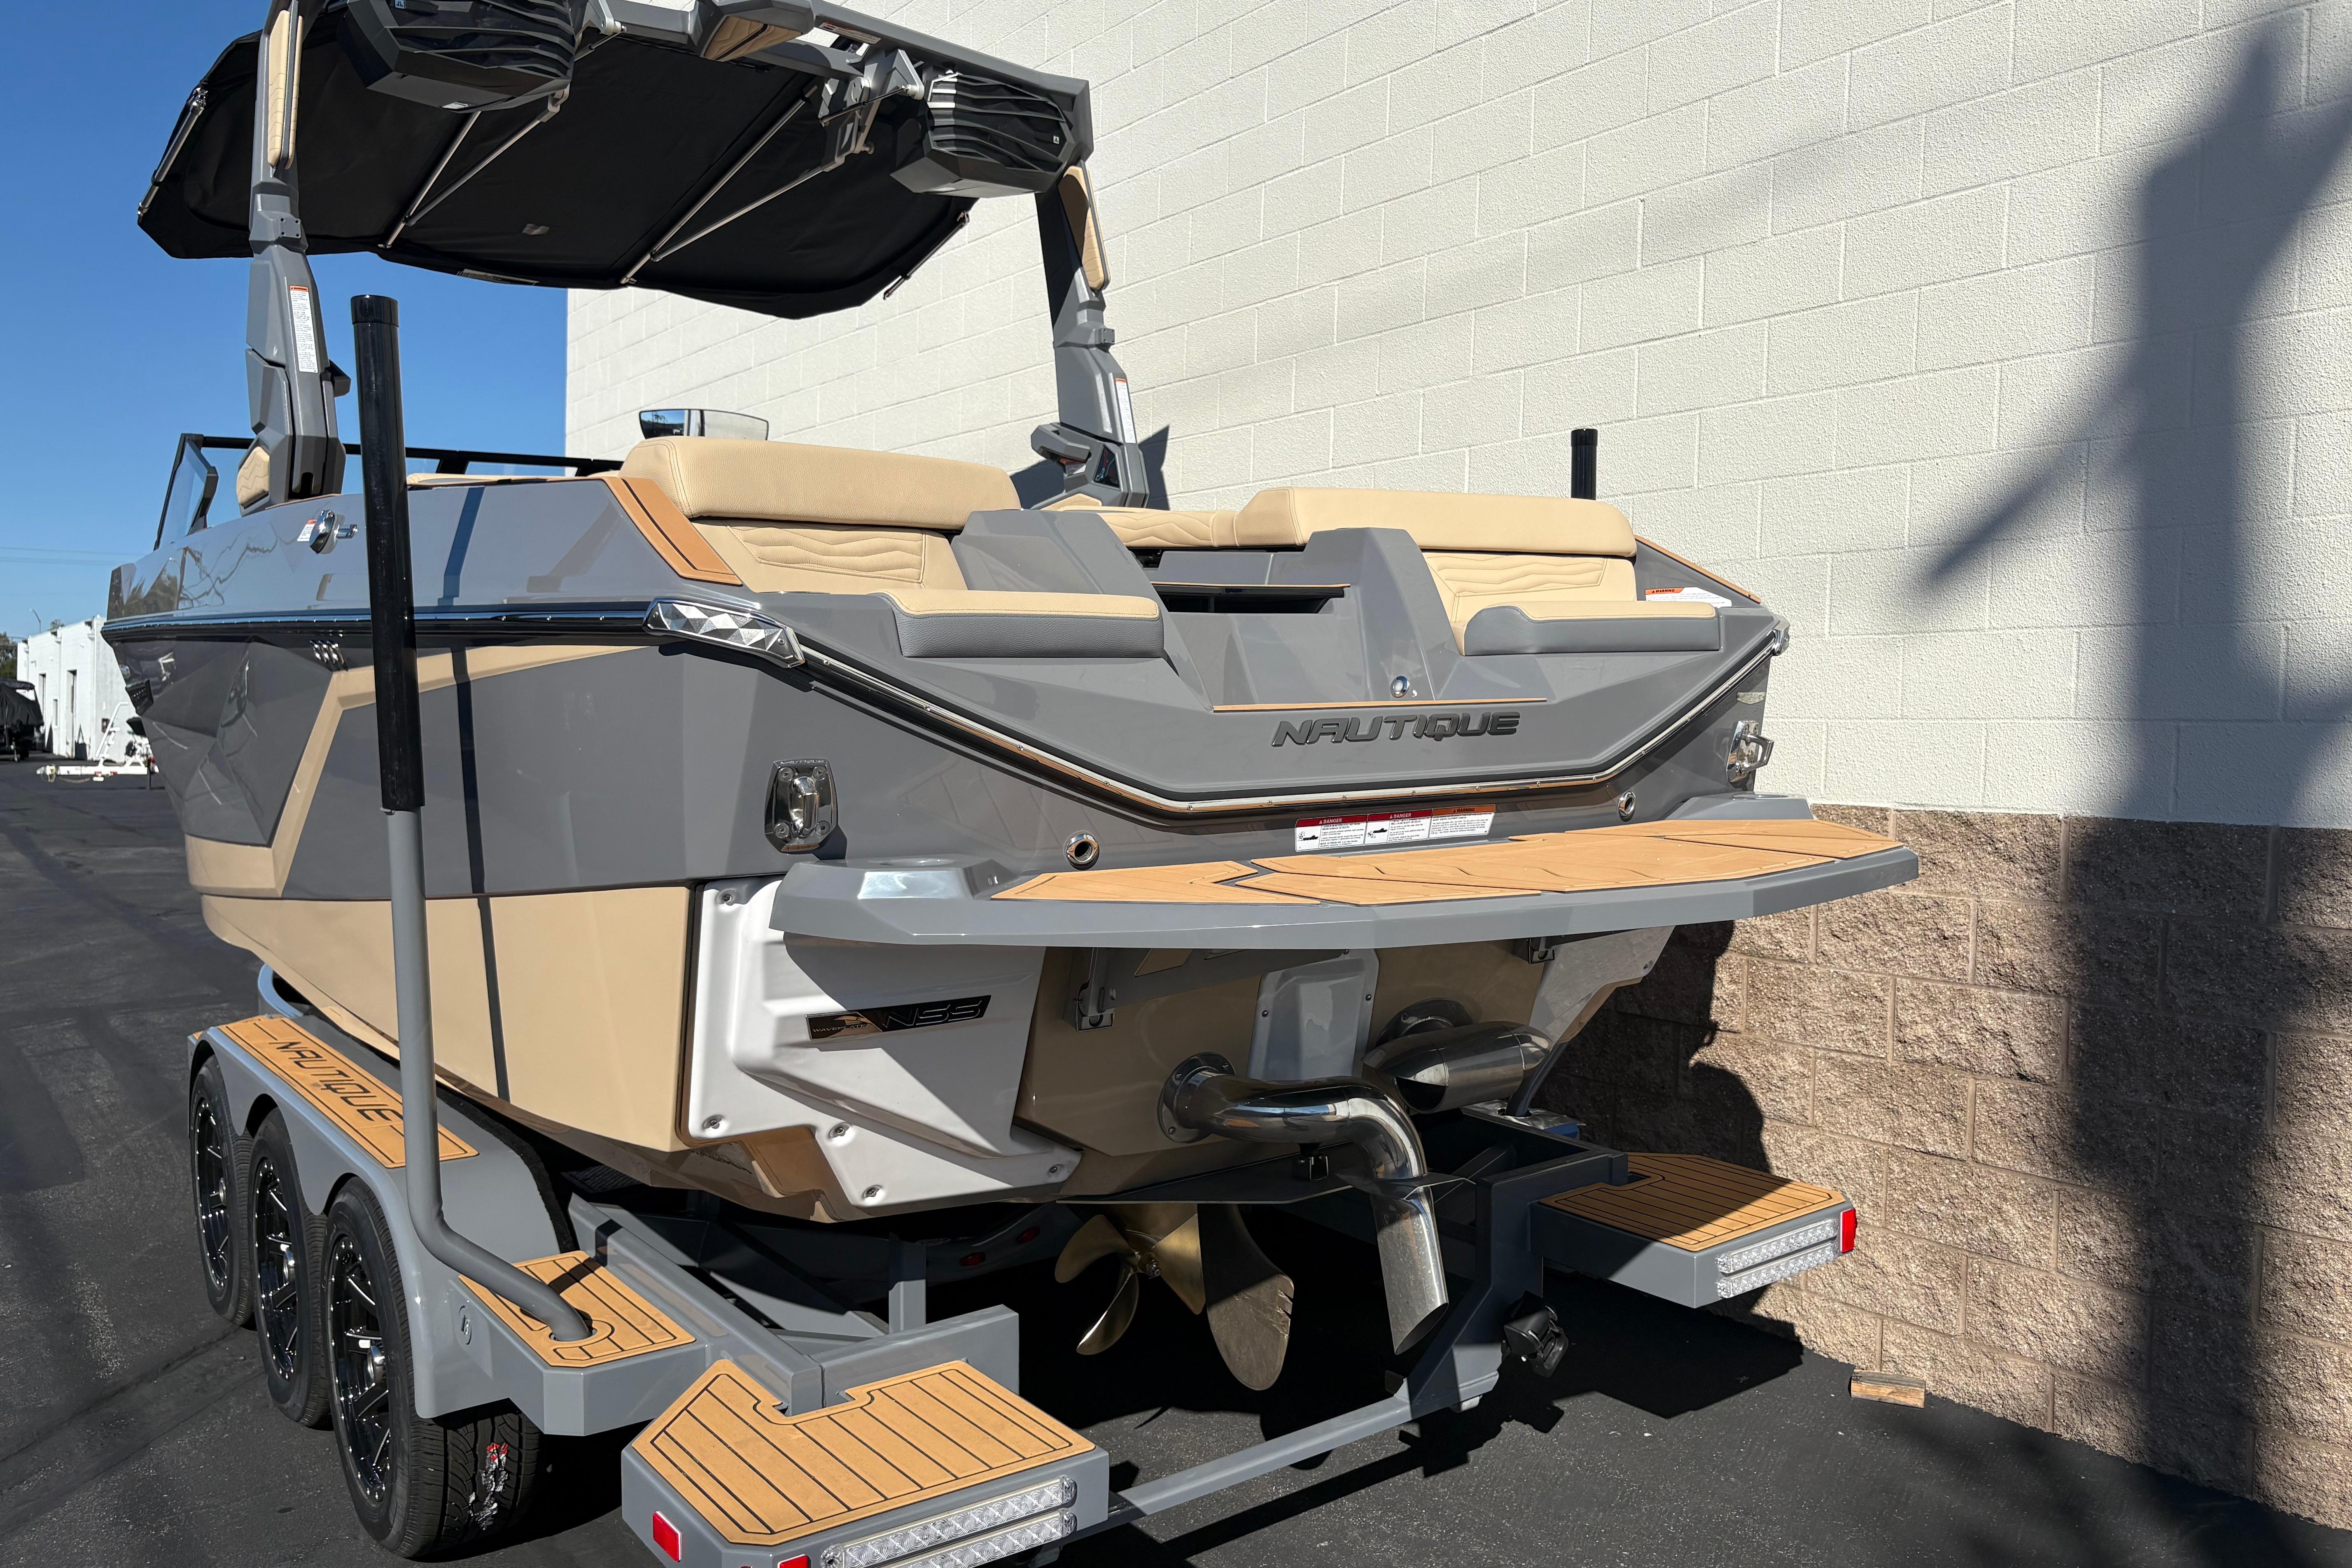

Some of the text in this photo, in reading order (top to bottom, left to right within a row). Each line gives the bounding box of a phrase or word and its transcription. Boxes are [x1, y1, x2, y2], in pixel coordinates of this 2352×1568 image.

[1272, 712, 1521, 747] NAUTIQUE
[882, 1000, 982, 1028] NSS
[268, 1041, 404, 1122] NAUTIQUE
